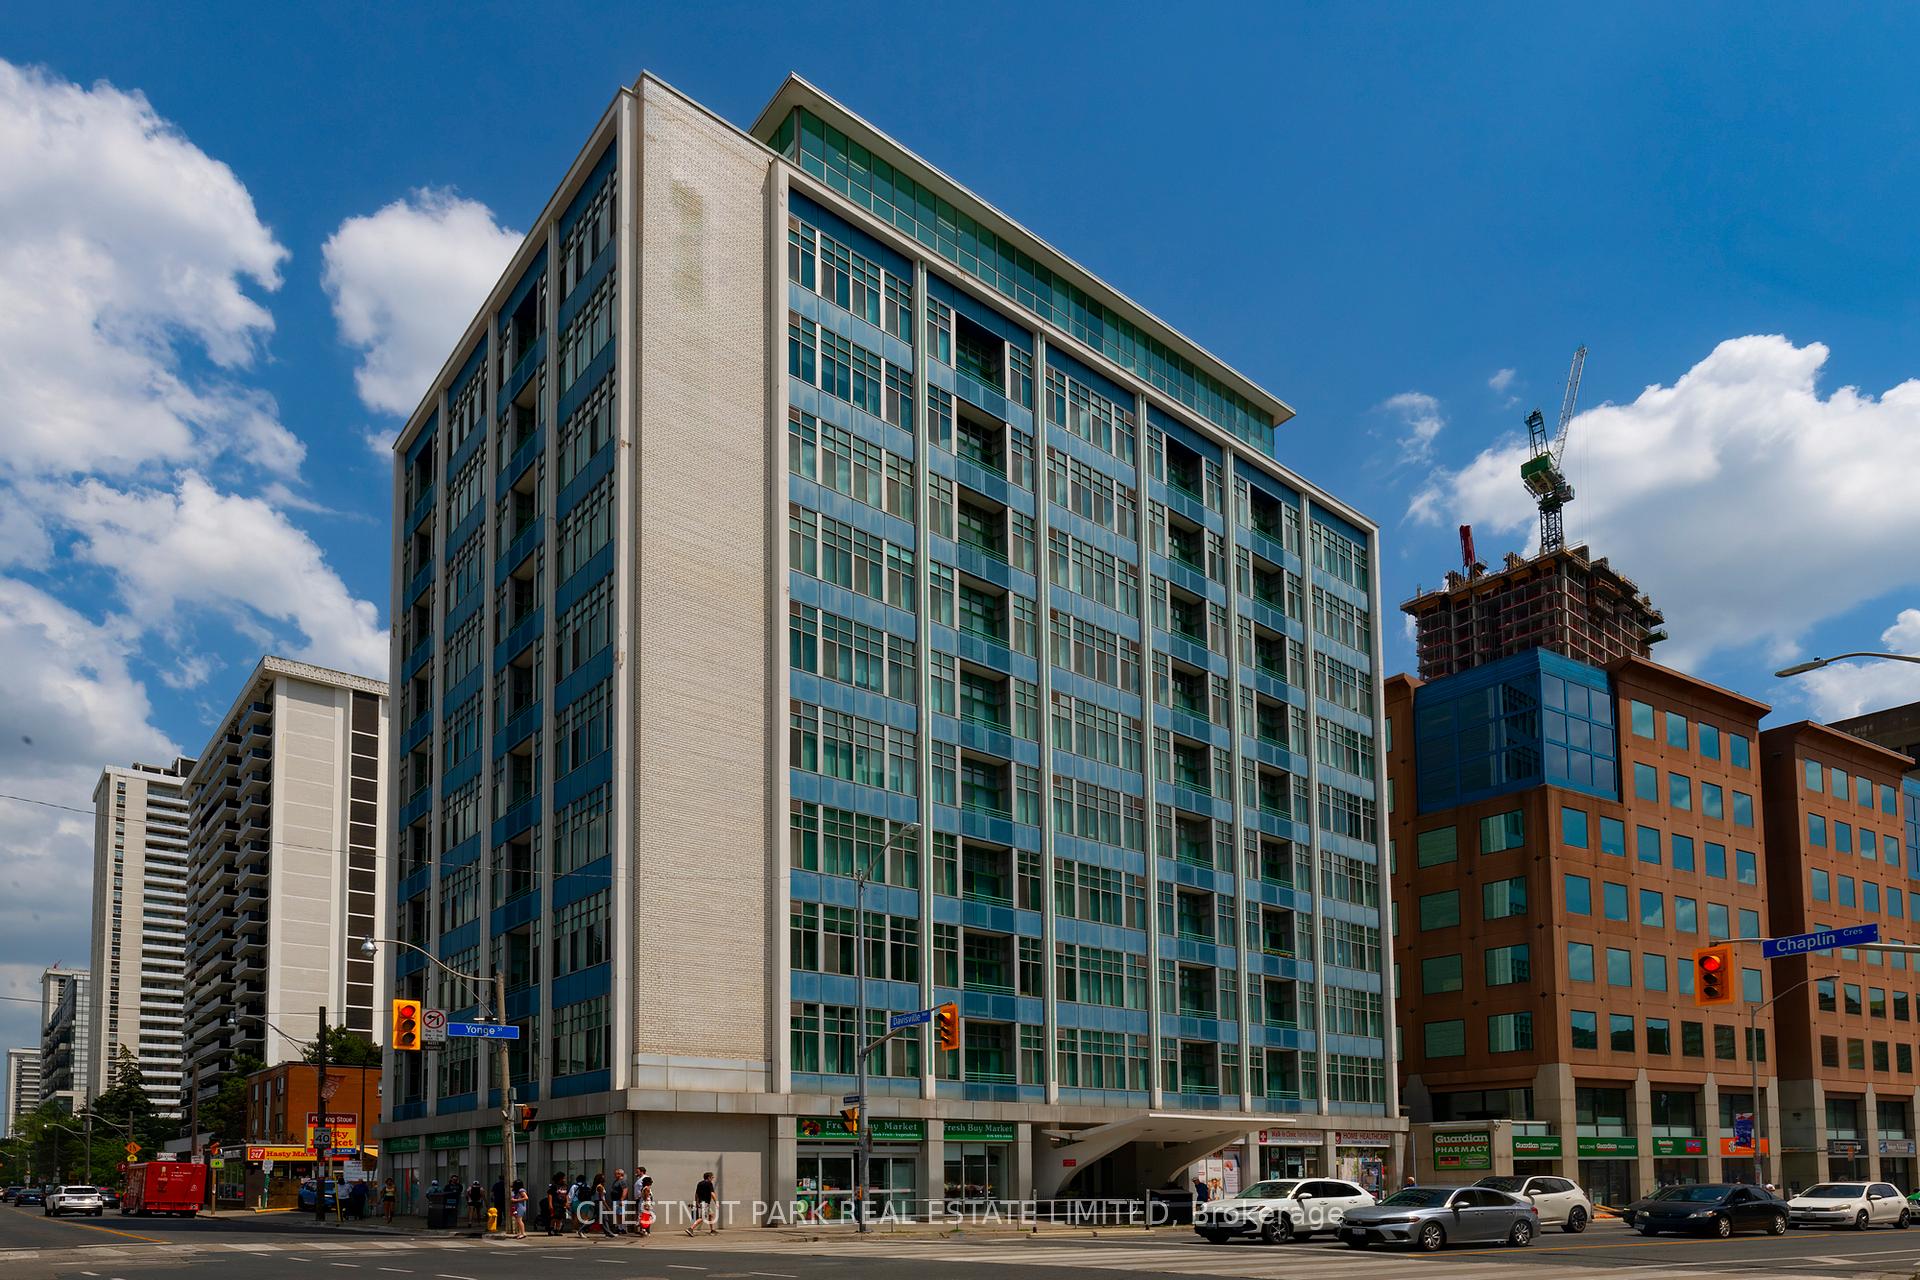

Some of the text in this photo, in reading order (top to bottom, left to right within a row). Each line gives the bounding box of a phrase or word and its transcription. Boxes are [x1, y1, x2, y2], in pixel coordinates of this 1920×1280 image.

[1776, 933, 1836, 951] Chaplin
[893, 1013, 921, 1026] Davisville
[465, 1025, 496, 1036] Yonge
[885, 1121, 918, 1131] Market
[944, 1122, 1013, 1133] Fresh Buy Market
[315, 1134, 330, 1143] 40
[1435, 1134, 1489, 1144] Guardian
[1435, 1145, 1488, 1153] PHARMACY
[1515, 1141, 1540, 1149] Guardian
[266, 1151, 290, 1159] Hasty
